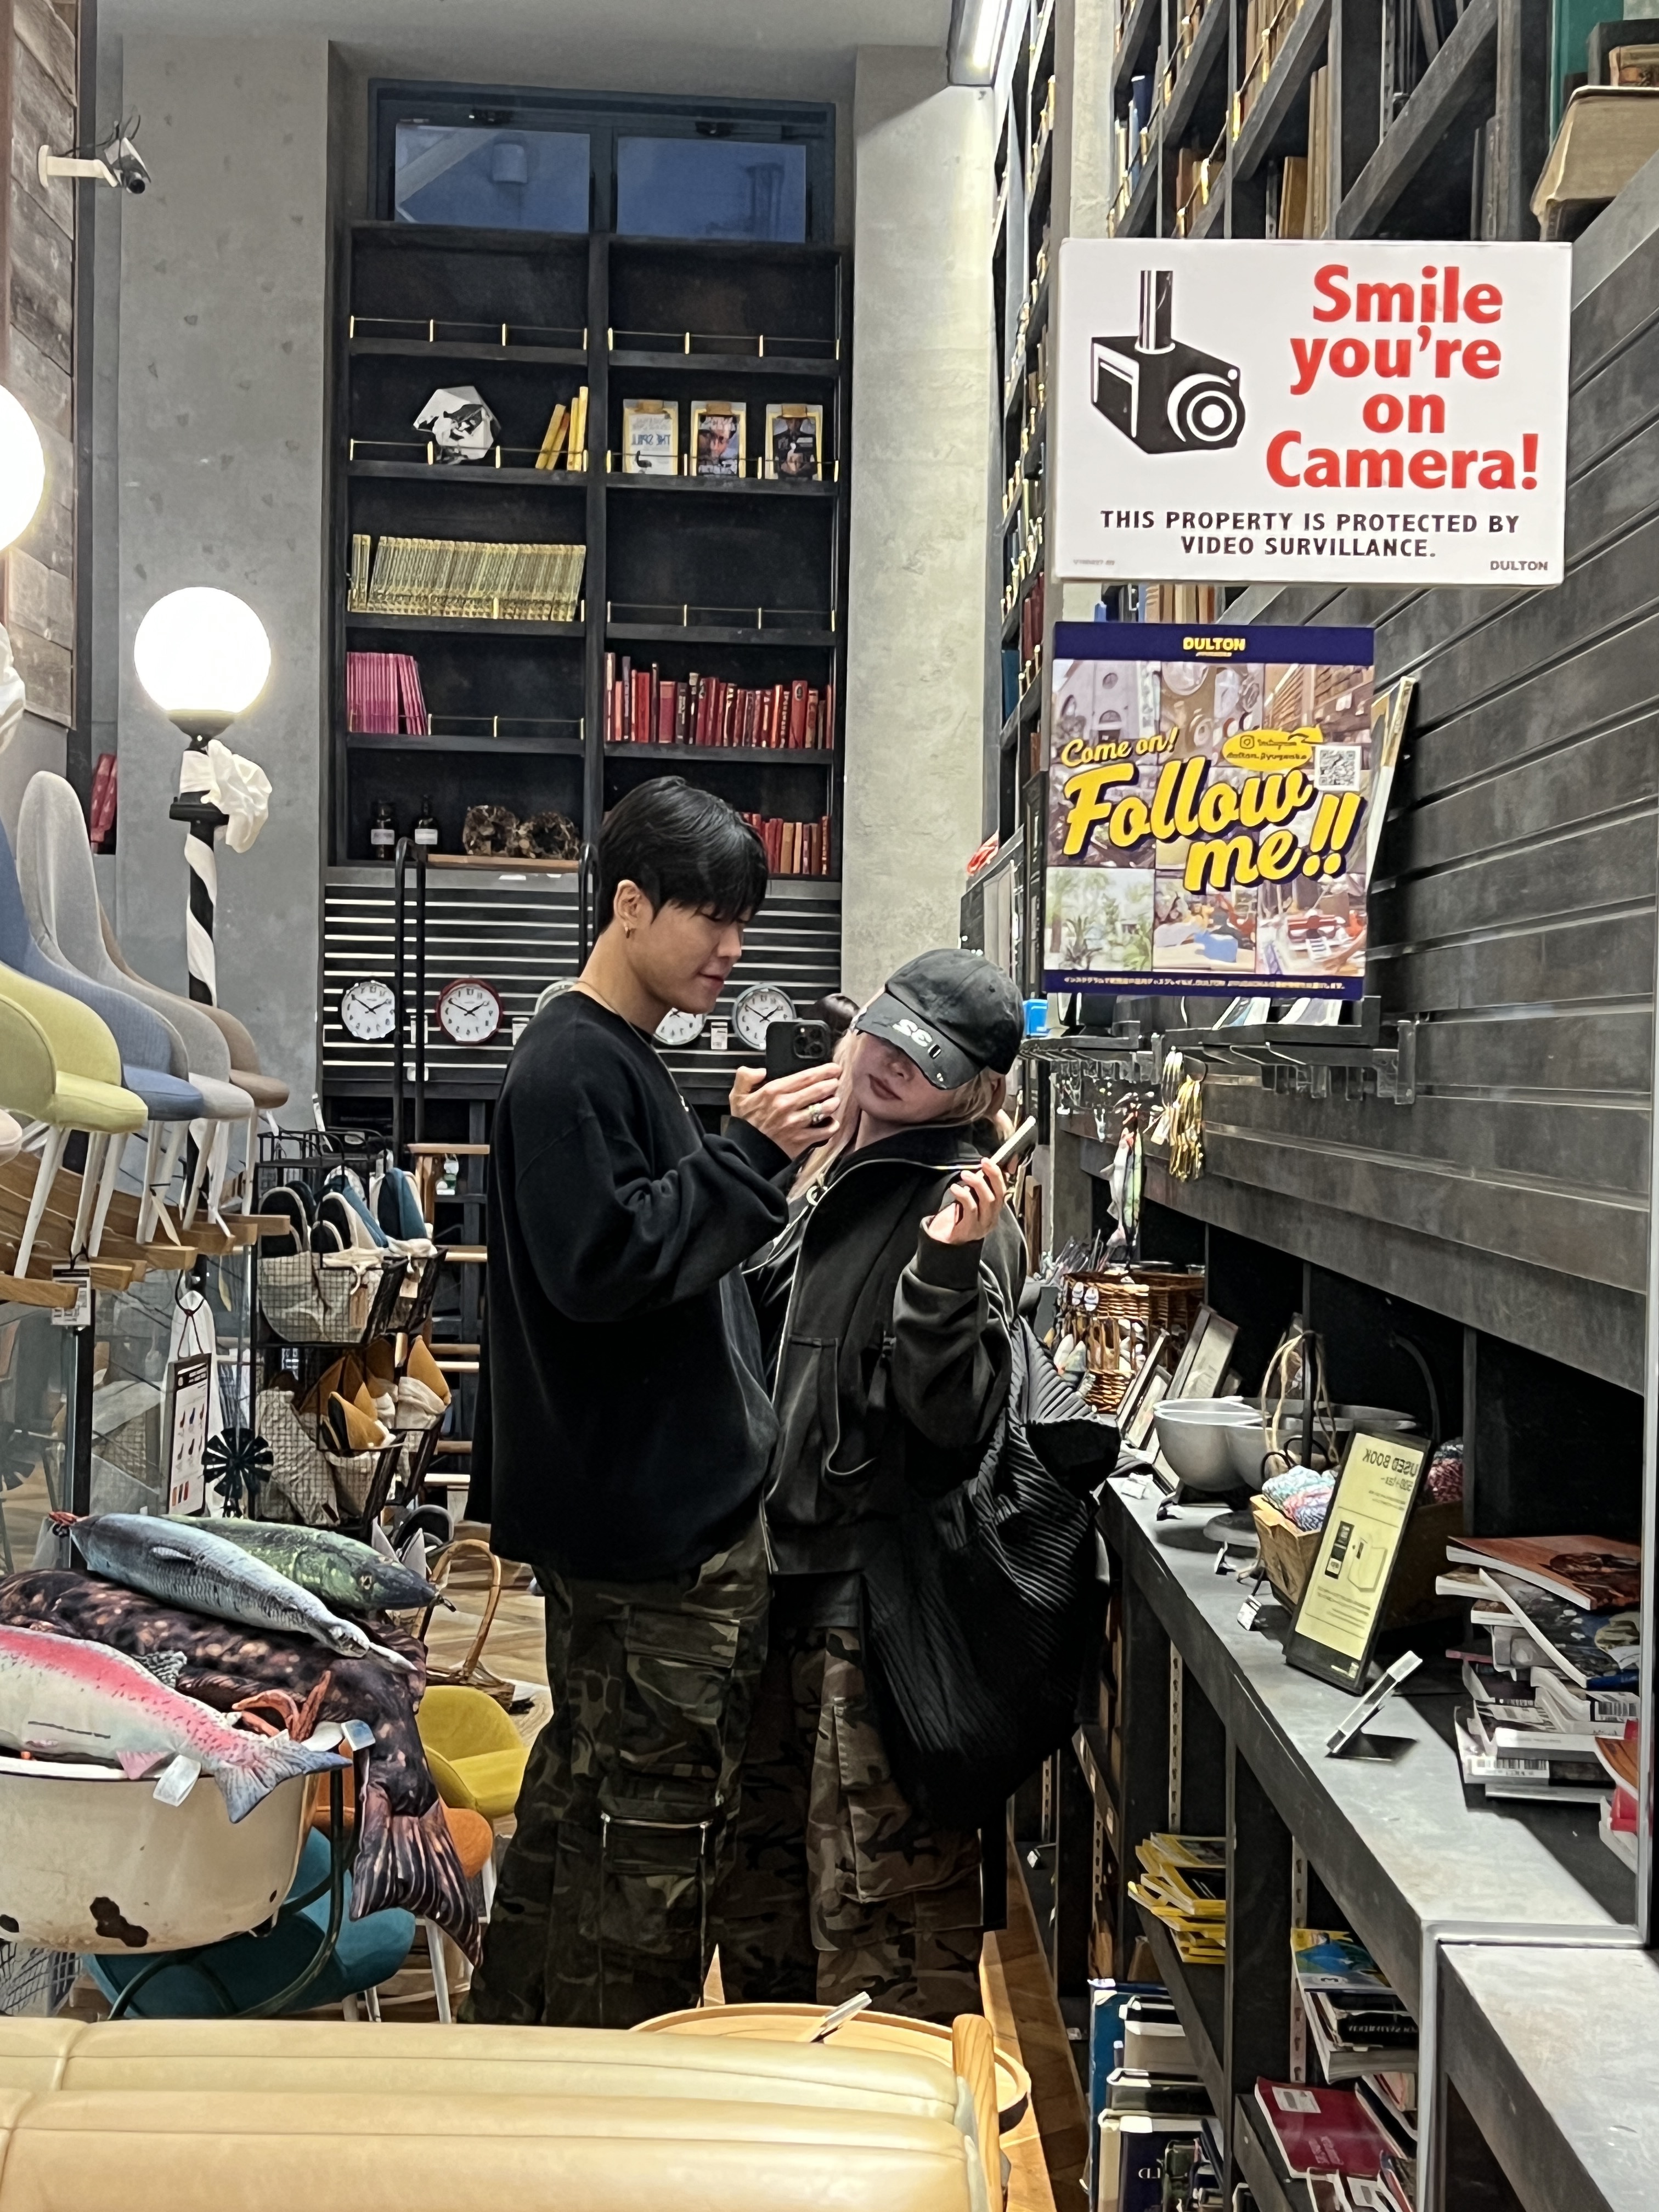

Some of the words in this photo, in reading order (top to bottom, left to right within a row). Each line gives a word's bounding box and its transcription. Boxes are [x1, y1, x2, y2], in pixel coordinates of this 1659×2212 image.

[1313, 264, 1503, 324] Smile
[1363, 393, 1445, 433] on
[1266, 430, 1539, 490] Camera!
[1101, 510, 1154, 528] THIS
[1166, 511, 1293, 531] PROPERTY
[1305, 513, 1325, 531] IS
[1337, 514, 1477, 532] PROTECTED
[1489, 515, 1520, 533] BY
[1181, 536, 1254, 555] VIDEO
[1265, 537, 1436, 557] SURVILLANCE.
[1490, 560, 1548, 571] DULTON
[1183, 636, 1246, 651] DULTON
[1061, 738, 1132, 768] Come
[1135, 726, 1179, 755] on!
[1062, 756, 1313, 856] Follow
